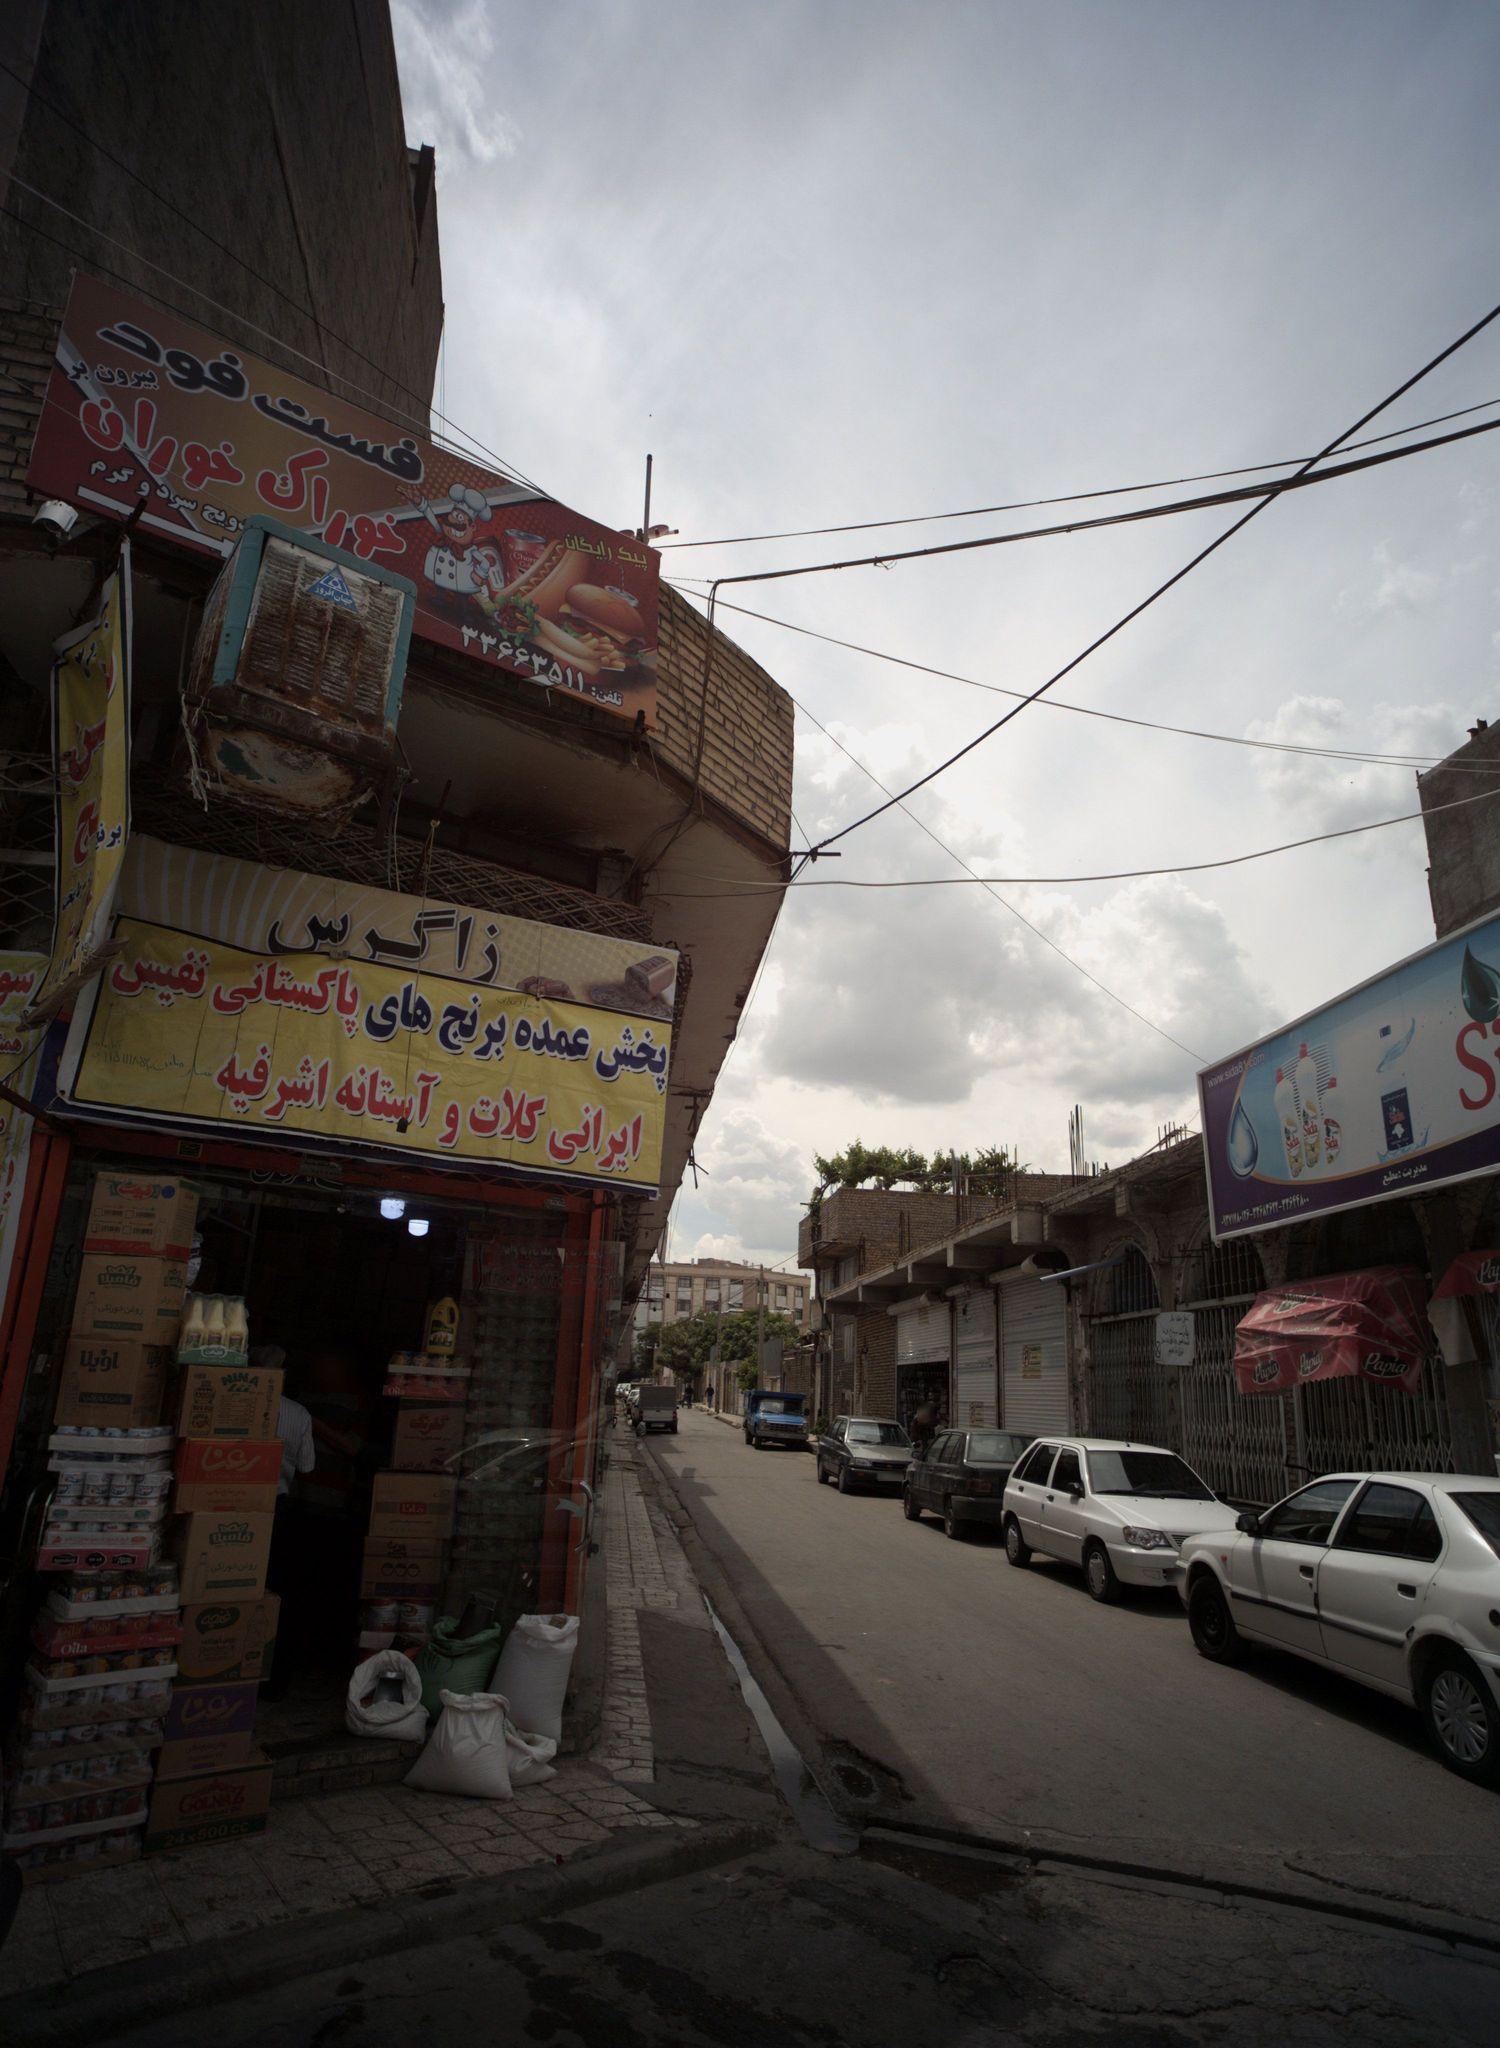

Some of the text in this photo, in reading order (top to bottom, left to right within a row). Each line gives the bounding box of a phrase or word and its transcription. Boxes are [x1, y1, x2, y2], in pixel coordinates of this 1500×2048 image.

[67, 360, 158, 390] بیرون بر
[97, 321, 423, 483] فست فود
[79, 397, 244, 491] خوران
[89, 459, 135, 484] گرم
[136, 481, 151, 497] و
[155, 485, 198, 511] سرد
[564, 533, 648, 570] پیک رایگان
[267, 908, 500, 983] زاگرس
[109, 951, 667, 1094] پخش عمده برنج های پاکستانی نفیس
[215, 1044, 330, 1120] اشرفیه
[335, 1065, 441, 1128] آستانه
[436, 1100, 461, 1148] و
[467, 1087, 547, 1143] کلات
[546, 1105, 643, 1172] ایرانی
[1254, 1359, 1287, 1382] Papia
[1299, 1350, 1320, 1374] Papia
[1364, 1351, 1408, 1375] Papia
[60, 1641, 88, 1656] Oila
